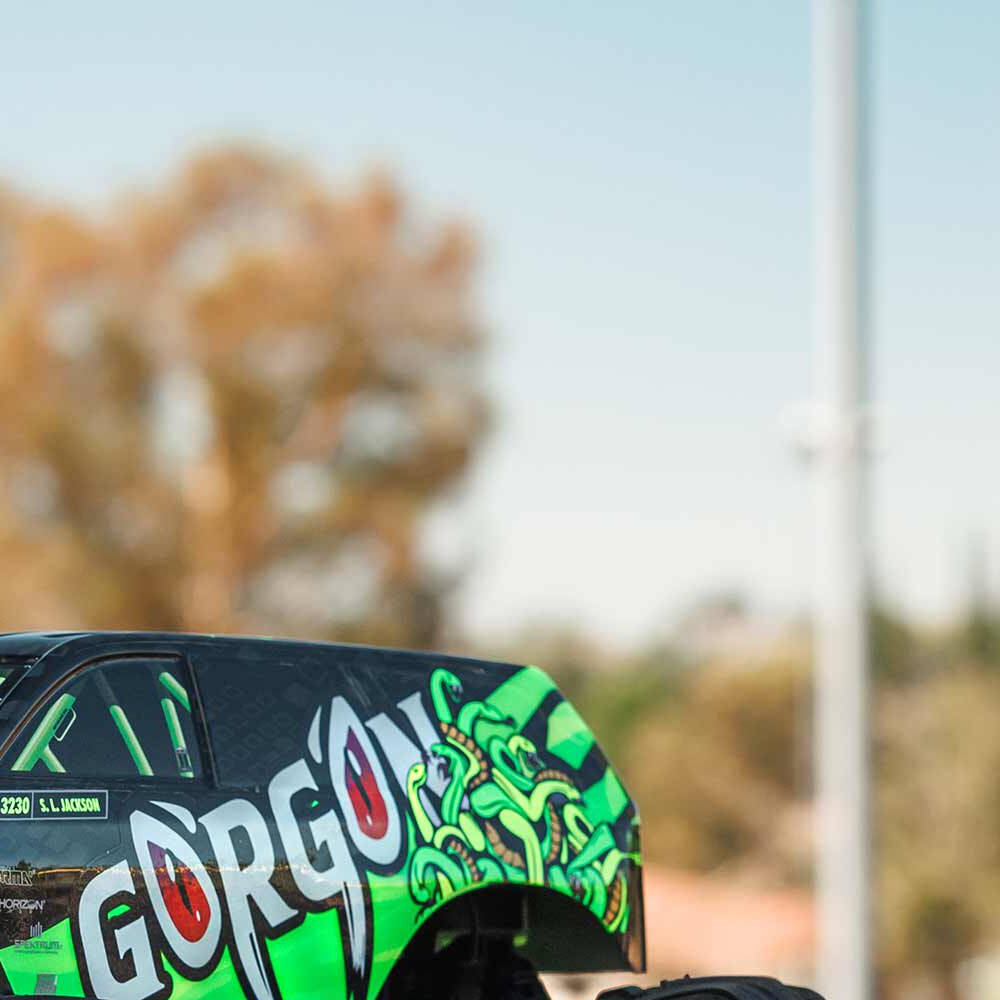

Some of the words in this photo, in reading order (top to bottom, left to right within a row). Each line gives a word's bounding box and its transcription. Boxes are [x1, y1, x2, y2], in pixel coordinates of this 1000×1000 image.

[0, 796, 30, 815] 3230
[39, 798, 50, 812] S.
[50, 798, 60, 812] L.
[61, 797, 101, 812] JACKSON
